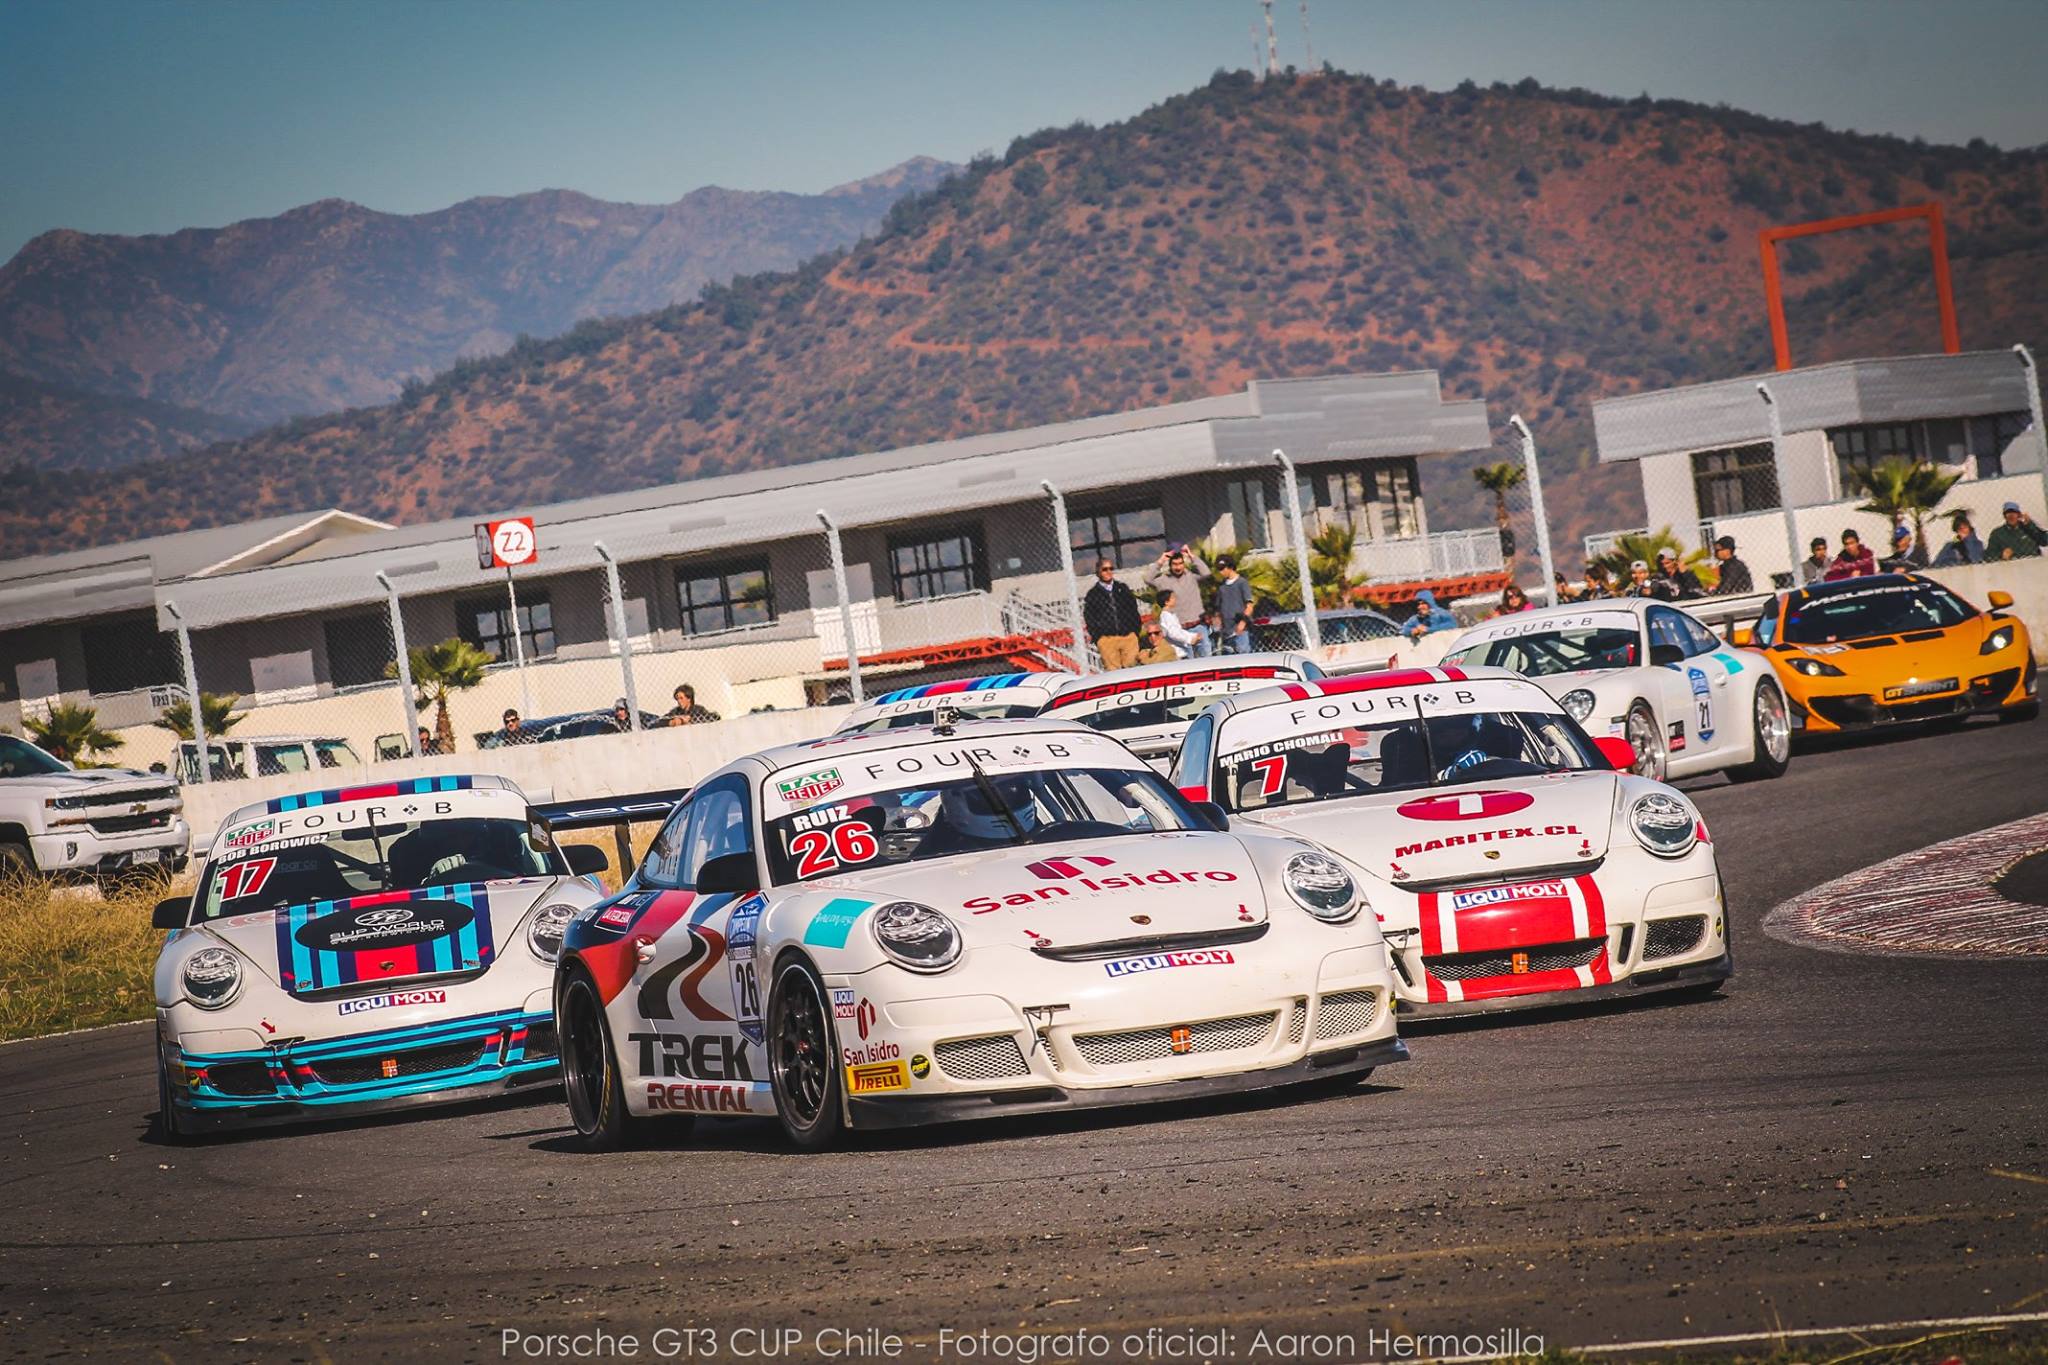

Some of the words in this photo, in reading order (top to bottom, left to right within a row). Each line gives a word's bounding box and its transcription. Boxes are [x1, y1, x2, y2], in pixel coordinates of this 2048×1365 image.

[500, 531, 526, 552] Z2
[1489, 621, 1553, 640] FOUR
[1580, 617, 1593, 626] B
[878, 697, 951, 717] FOUR
[982, 692, 996, 702] B
[1096, 686, 1186, 710] FOUR
[1226, 682, 1241, 692] B
[1291, 696, 1407, 725] FOUR
[1456, 691, 1476, 704] B
[1699, 701, 1710, 729] 21
[866, 748, 997, 780] FOUR
[1046, 744, 1070, 758] B
[1219, 745, 1270, 769] MARIO
[1273, 731, 1344, 753] CHOMALI
[783, 769, 838, 790] TAG
[1251, 754, 1288, 798] 7
[784, 780, 840, 800] HEUER
[228, 821, 273, 840] TAG
[279, 807, 386, 833] FOUR
[435, 802, 452, 814] B
[792, 805, 852, 832] RUIZ
[218, 848, 247, 865] BOB
[249, 833, 329, 856] BOROWICZ
[227, 829, 273, 846] HEUER
[789, 820, 879, 880] 26
[1395, 825, 1582, 858] MARITEX.CL
[217, 857, 278, 903] 17
[962, 885, 1070, 915] San
[1079, 869, 1238, 891] Isidro
[1455, 890, 1509, 909] LIQUI
[1513, 884, 1564, 899] MOLY
[372, 919, 445, 933] WORLD
[1107, 953, 1169, 977] LIQUI
[1171, 950, 1233, 967] MOLY
[341, 996, 390, 1014] LIQUI
[394, 991, 445, 1006] MOLY
[736, 962, 761, 1017] 26
[835, 991, 854, 1004] LIQUI
[836, 1004, 855, 1017] MOLY
[628, 1033, 753, 1080] TREK
[844, 1048, 865, 1067] San
[866, 1040, 900, 1062] Isidro
[853, 1065, 902, 1090] PIRELLI
[647, 1083, 753, 1113] RENTAL
